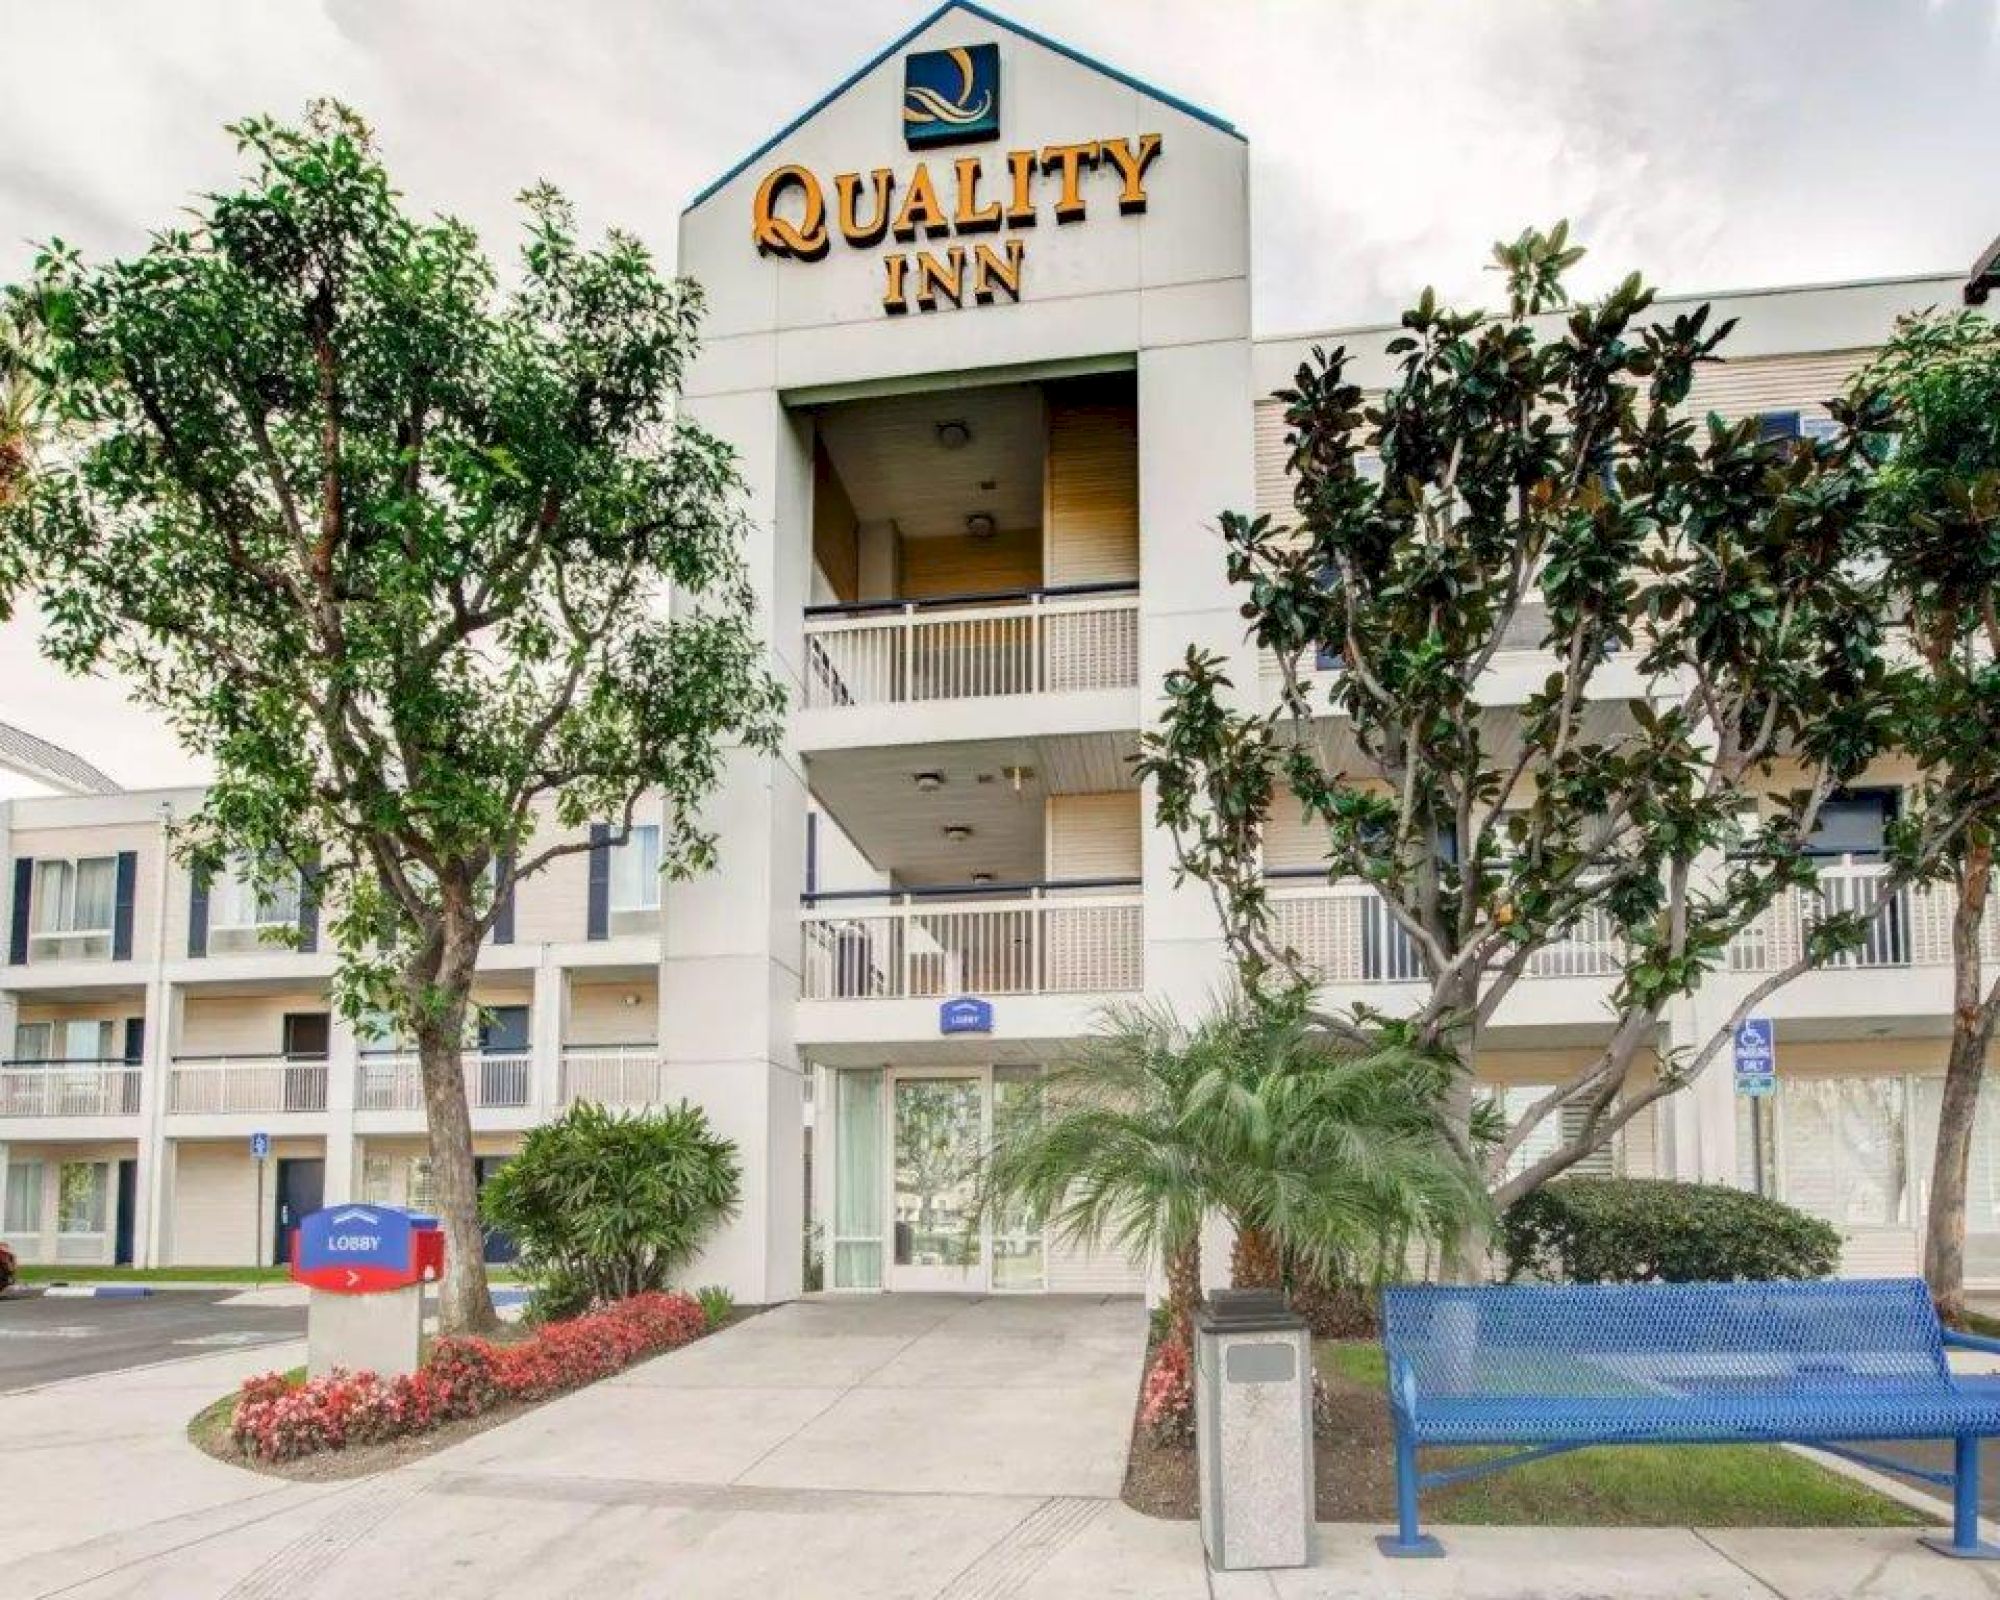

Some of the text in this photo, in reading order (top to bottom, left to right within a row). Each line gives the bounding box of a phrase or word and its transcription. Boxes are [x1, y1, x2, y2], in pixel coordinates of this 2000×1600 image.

[753, 133, 1162, 260] QUALITY
[882, 240, 1024, 314] INN
[328, 1235, 381, 1251] LOBBY
